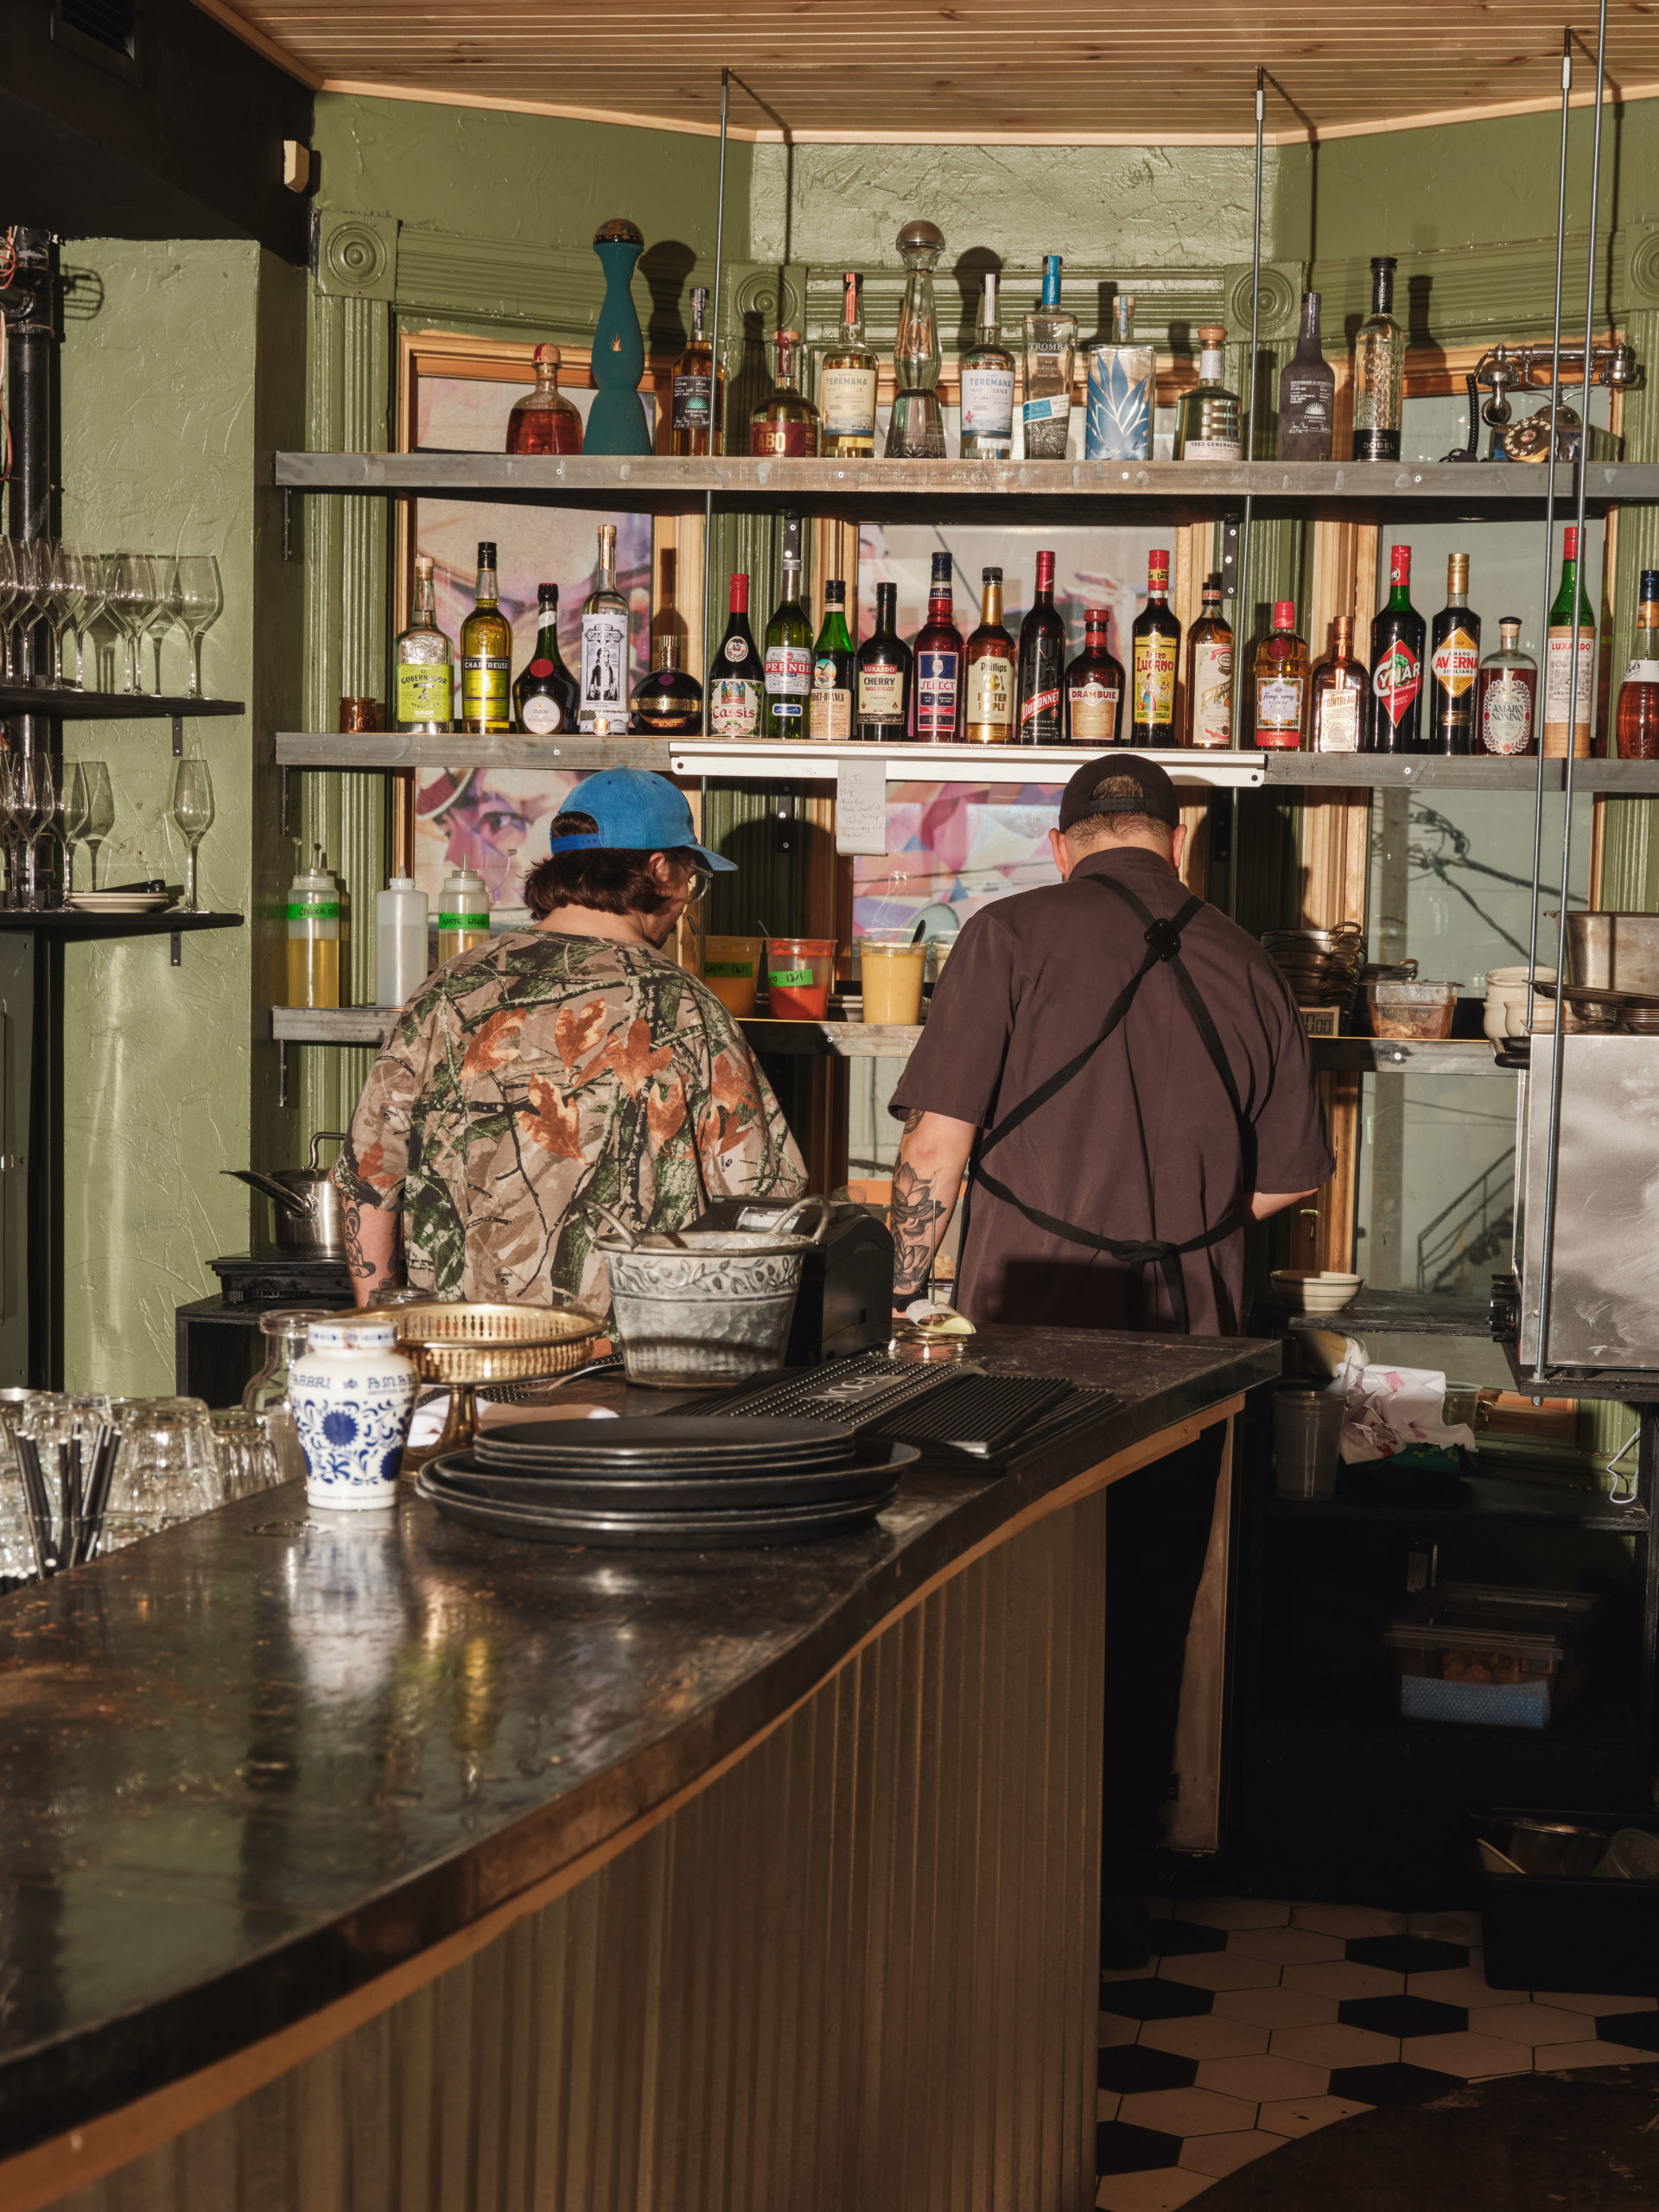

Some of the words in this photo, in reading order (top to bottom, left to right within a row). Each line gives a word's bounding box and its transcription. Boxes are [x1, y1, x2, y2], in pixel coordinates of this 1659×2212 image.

[1029, 343, 1069, 353] TROMBA
[969, 378, 1012, 388] TEREMANA
[757, 432, 786, 452] ABO
[1551, 642, 1591, 651] LUXDO
[1146, 651, 1166, 659] AMARO
[981, 662, 1007, 673] Phillips
[1136, 657, 1174, 673] LUCANO
[1435, 657, 1478, 670] AVERNA
[401, 674, 448, 685] GOBERNADOR
[864, 677, 895, 686] CHERRY
[1373, 660, 1421, 697] CYNAR
[919, 681, 956, 690] SELECT
[977, 692, 1007, 702] BTER
[1071, 690, 1116, 699] DRAMBUIE
[1262, 691, 1295, 702] Tanqeray
[713, 705, 755, 719] Cassis
[978, 702, 1006, 712] PPLE
[1492, 704, 1523, 713] AMARO
[1491, 712, 1523, 721] NONINO
[298, 906, 326, 917] CANOLA
[442, 918, 462, 926] WHITE
[291, 1373, 331, 1389] ABBRI
